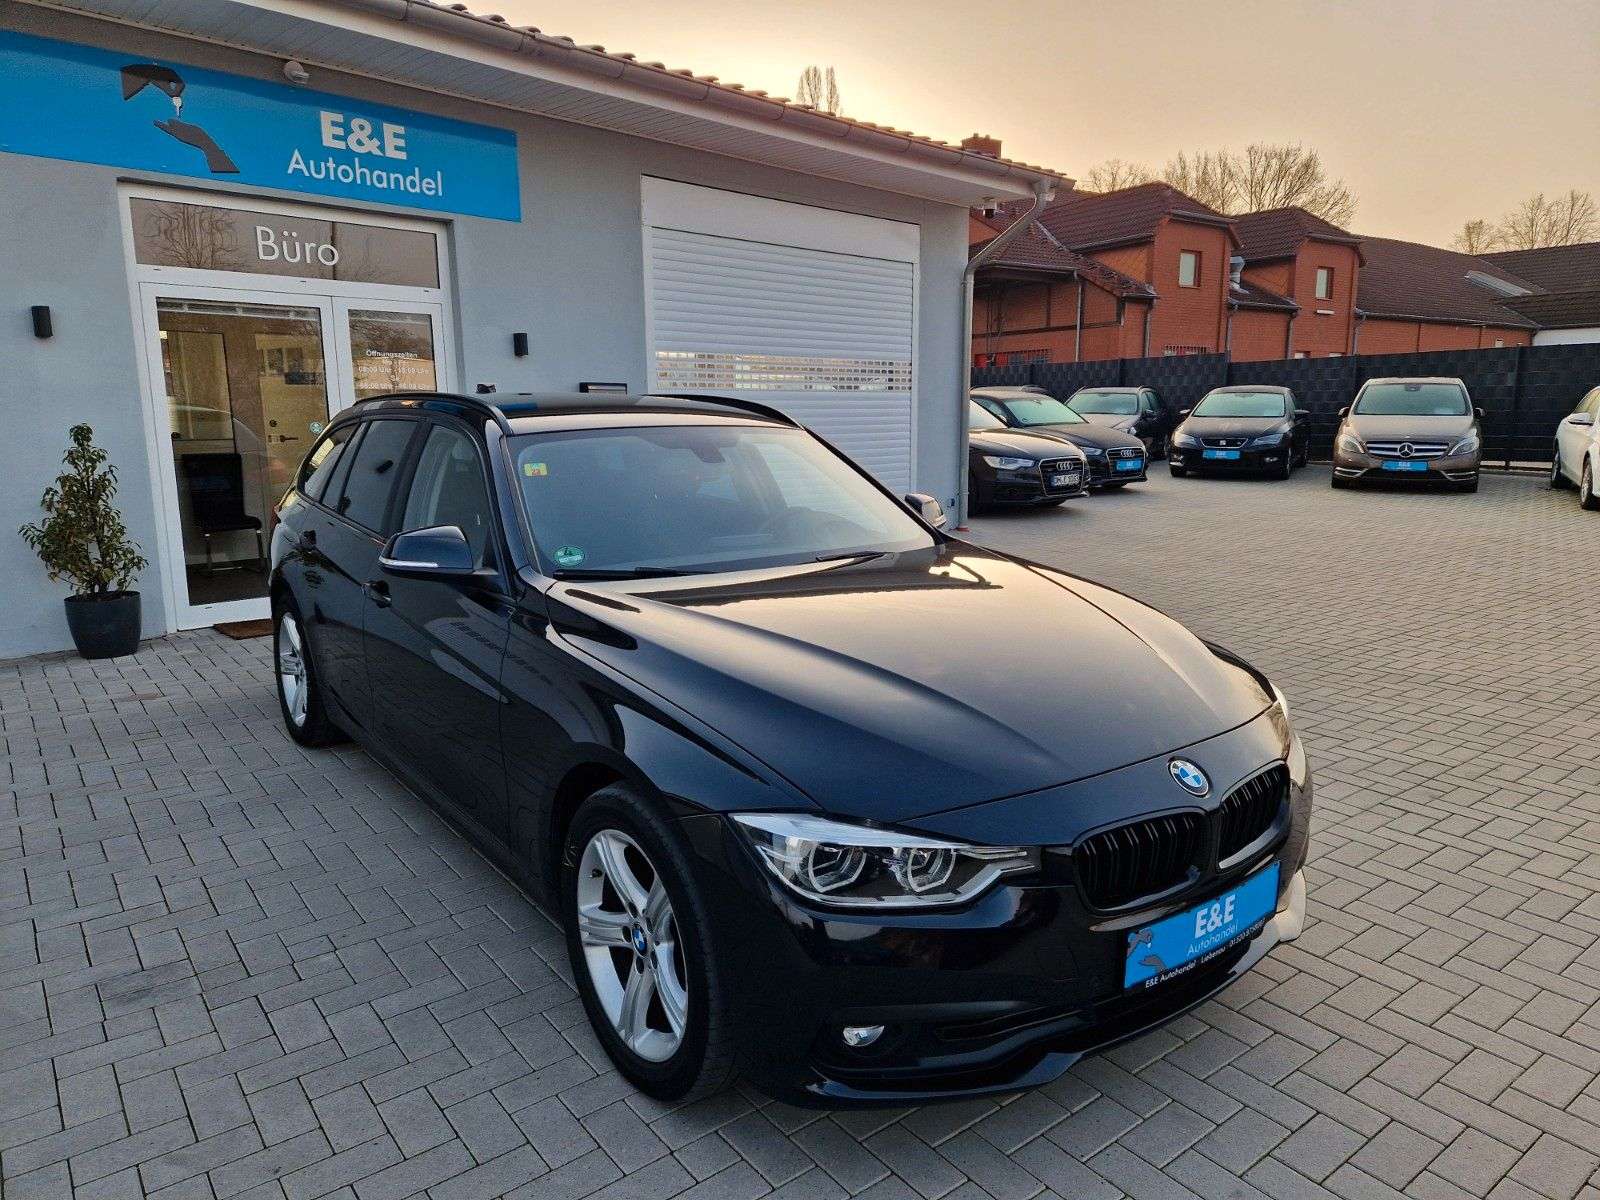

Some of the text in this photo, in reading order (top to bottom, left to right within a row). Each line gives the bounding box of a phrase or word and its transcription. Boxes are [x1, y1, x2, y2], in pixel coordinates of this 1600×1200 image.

[320, 111, 407, 160] E&E
[287, 148, 443, 197] Autohandel
[256, 226, 339, 266] Büro
[1187, 919, 1239, 956] Autohandel
[1194, 893, 1236, 939] E&E
